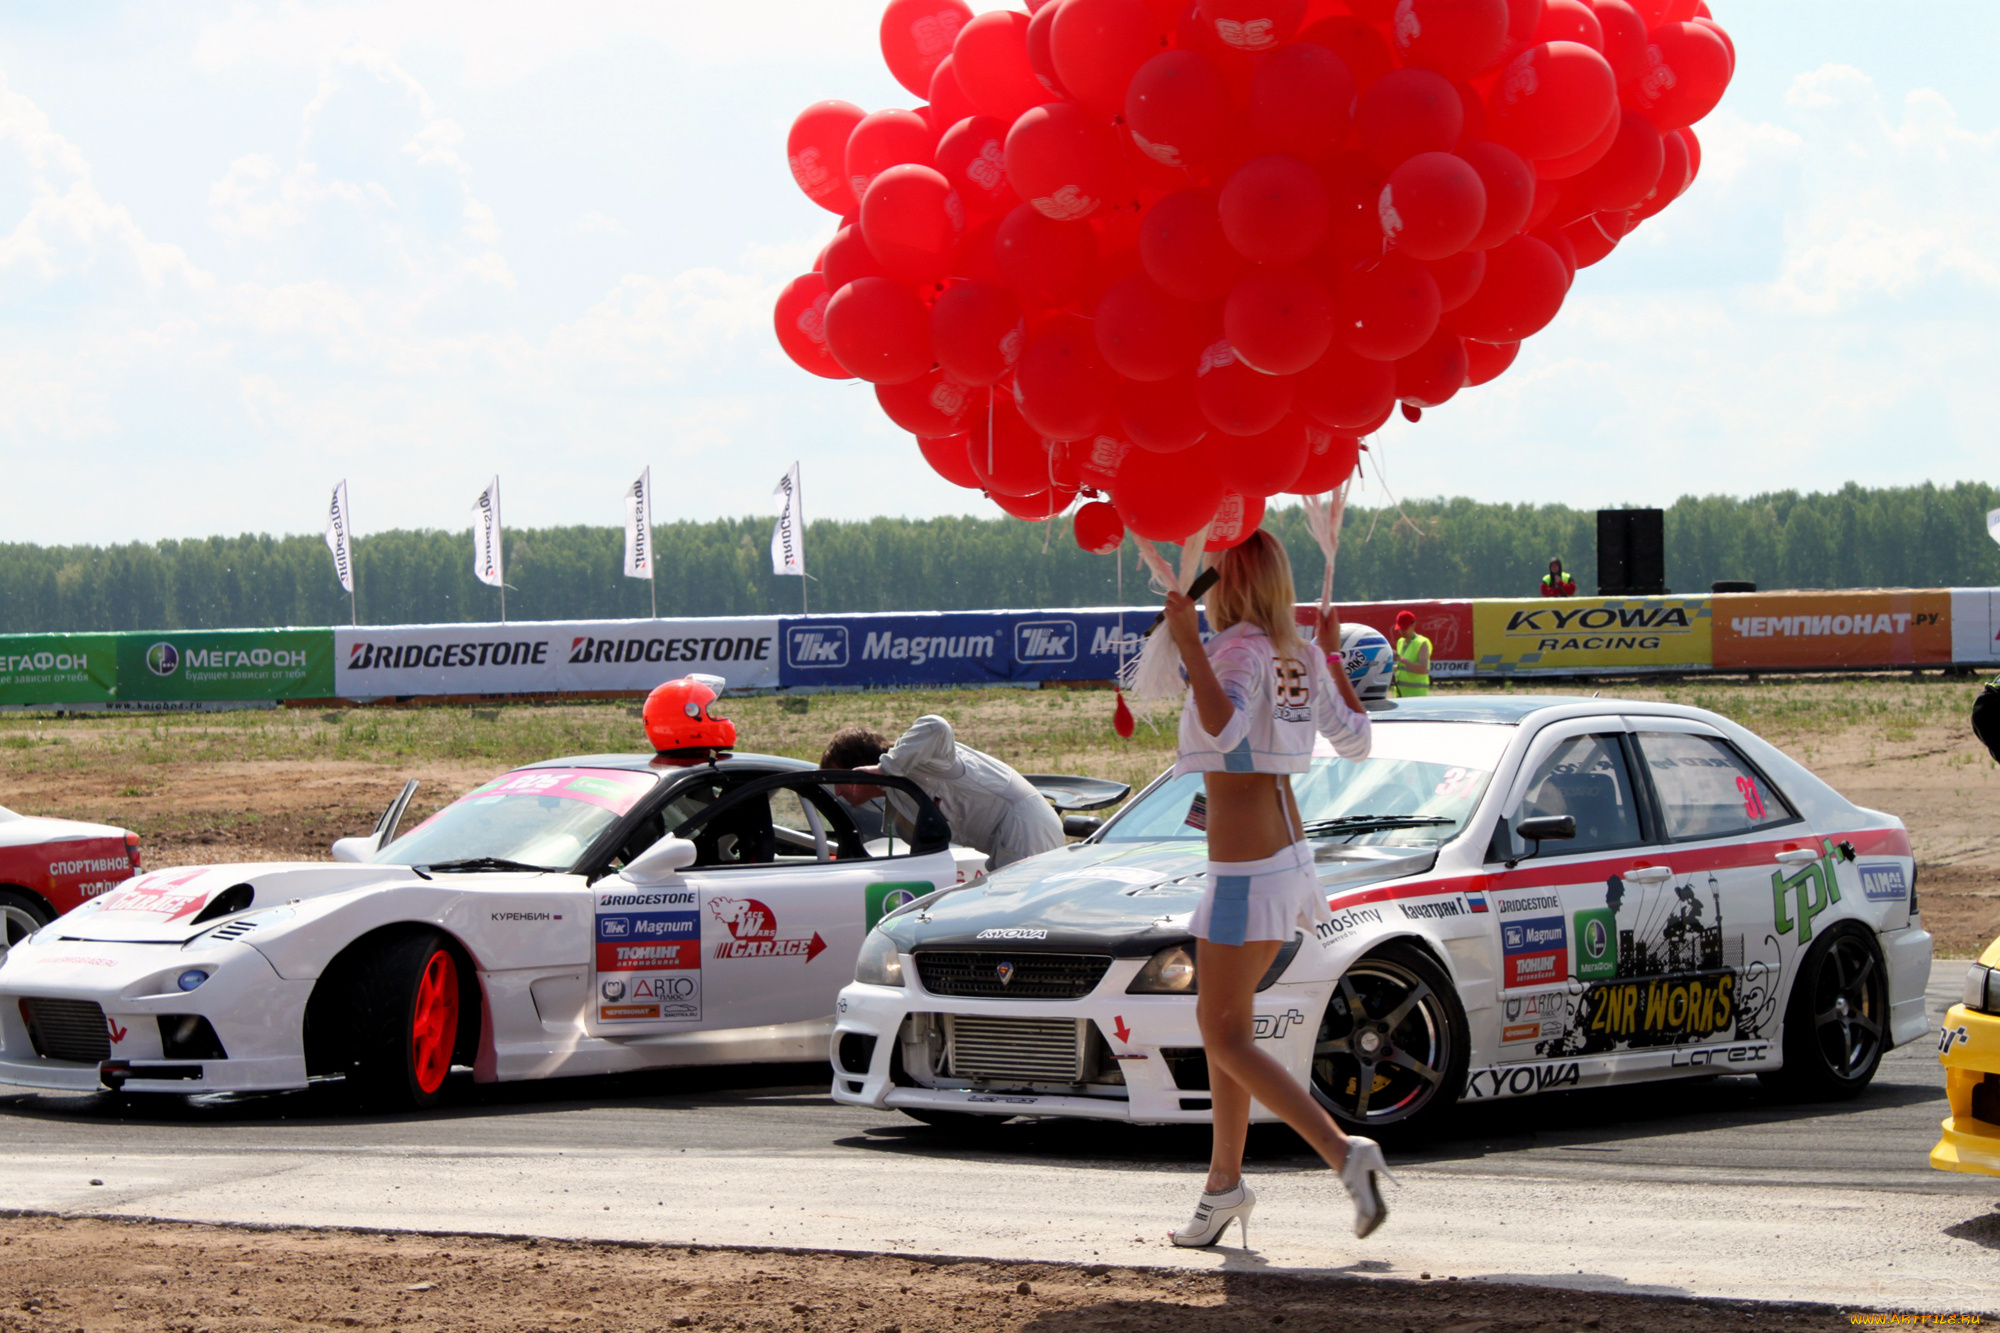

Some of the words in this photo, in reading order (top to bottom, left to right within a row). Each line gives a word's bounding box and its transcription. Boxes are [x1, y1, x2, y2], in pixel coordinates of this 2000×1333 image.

[1505, 607, 1691, 632] KYOWA
[1731, 612, 1940, 638] ЧЕМПИОНАТ.РУ
[568, 637, 772, 664] BRIDGESTONE
[861, 631, 995, 665] Magnum
[1537, 637, 1661, 651] RACING
[347, 641, 549, 670] BRIDGESTONE
[14, 674, 51, 684] зависит
[67, 671, 89, 682] тебя
[185, 670, 228, 681] Будущее
[230, 671, 269, 680] зависит
[284, 669, 306, 679] тебя
[1435, 767, 1483, 799] 31
[1735, 775, 1767, 820] 31
[49, 857, 130, 876] СПОРТИВНОЕ
[600, 893, 696, 906] BRIDGESTONE
[1498, 896, 1559, 913] BRIDGESTONE
[491, 912, 550, 921] КУРЕНБИН
[1398, 901, 1460, 920] Хачатрян
[634, 920, 694, 936] Magnum
[976, 928, 1050, 940] KYOWA
[1316, 909, 1384, 941] moshny
[1322, 931, 1349, 949] powered
[1526, 927, 1563, 945] Magnum
[616, 946, 680, 960] ТЮНИНГ
[730, 940, 812, 957] GARAGE
[1591, 984, 1638, 1035] 2NR
[1644, 974, 1733, 1034] WORKS
[1461, 1062, 1581, 1099] KYOWA
